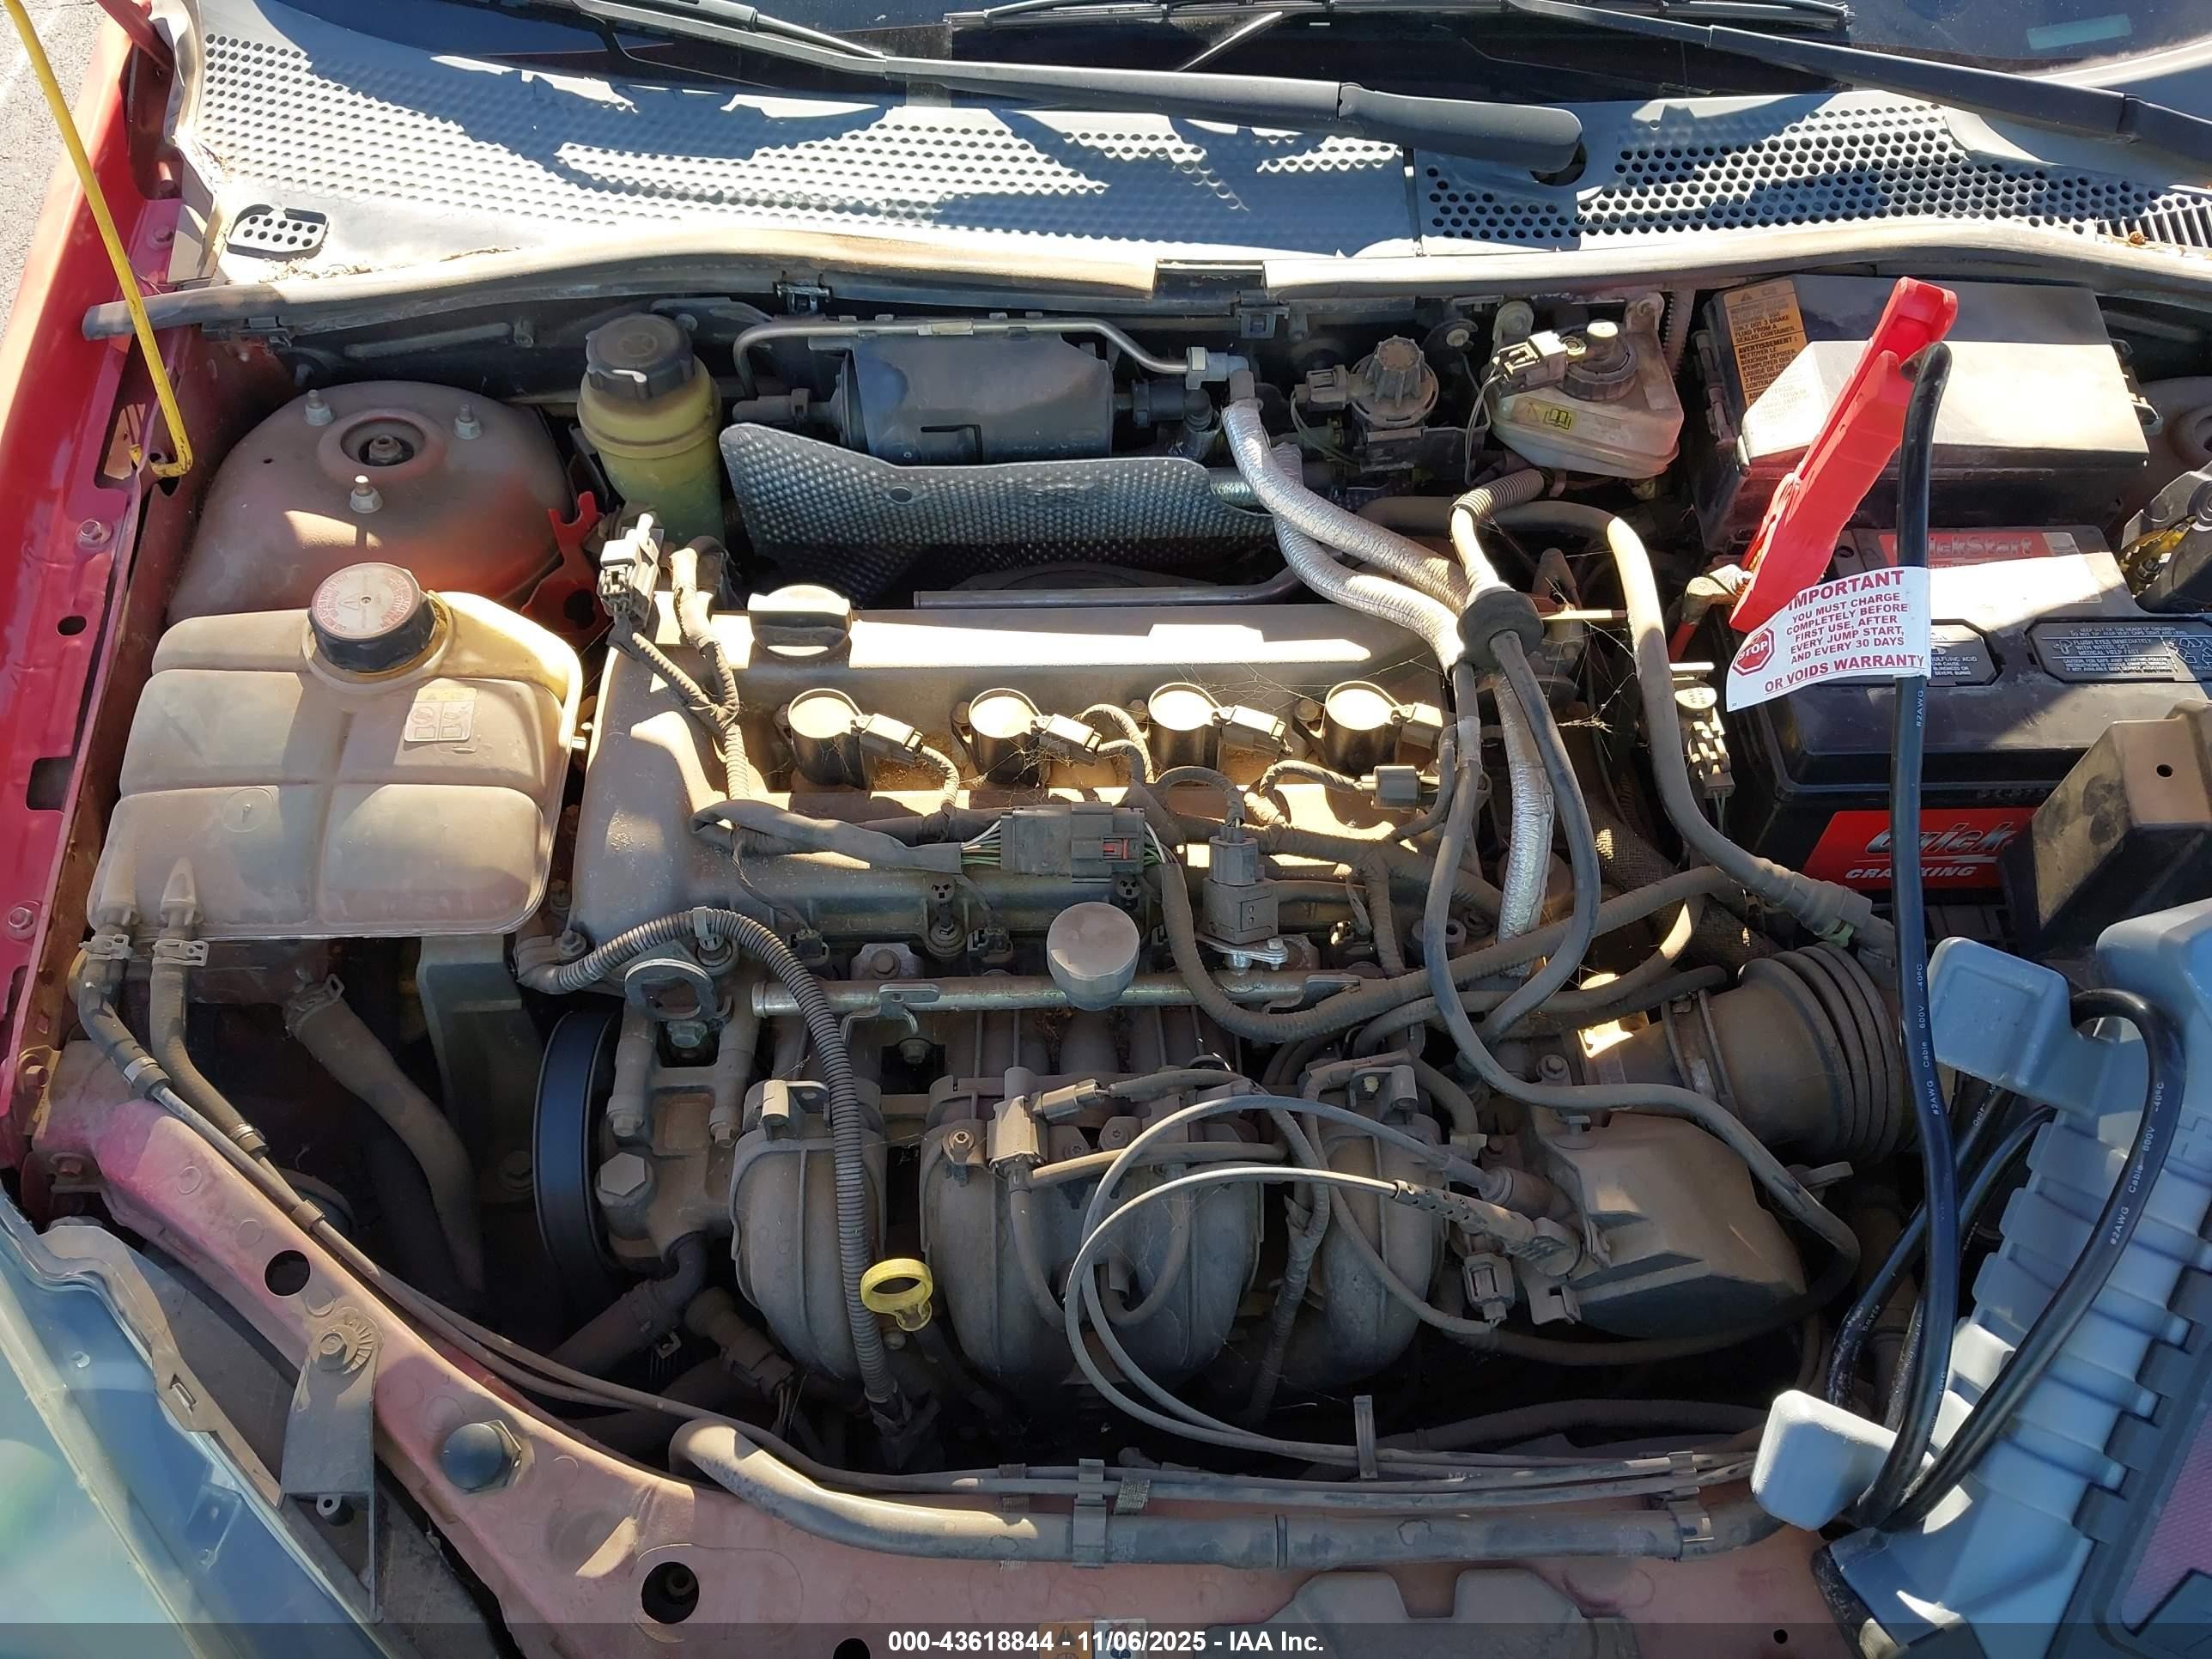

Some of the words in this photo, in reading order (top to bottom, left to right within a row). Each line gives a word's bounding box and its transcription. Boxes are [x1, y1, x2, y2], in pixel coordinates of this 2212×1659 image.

[1788, 570, 1905, 611] IMPORTANT
[1786, 610, 1856, 635] COMPLETELY
[1860, 603, 1908, 616] BEFORE
[1792, 611, 1813, 624] YOU
[1815, 601, 1847, 617] MUST
[1850, 592, 1900, 608] CHARGE
[1790, 637, 1823, 654] EVERY
[1826, 629, 1859, 644] JUMP
[1863, 626, 1905, 636] START,
[1795, 627, 1825, 643] FIRST
[1828, 621, 1854, 633] USE,
[1858, 615, 1898, 627] AFTER
[1737, 640, 1769, 661] STOP
[1791, 651, 1811, 665] AND
[1814, 642, 1851, 657] EVERY
[1856, 639, 1869, 648] 30
[1874, 637, 1905, 647] DAYS
[1765, 677, 1784, 693] OR
[1786, 662, 1829, 687] VOIDS
[1833, 654, 1924, 671] WARRANTY
[1845, 866, 1977, 879] CRAKING
[1927, 1079, 1940, 1115] #2AWG
[2110, 1206, 2130, 1245] #2AWG
[2129, 1164, 2144, 1194] Cable
